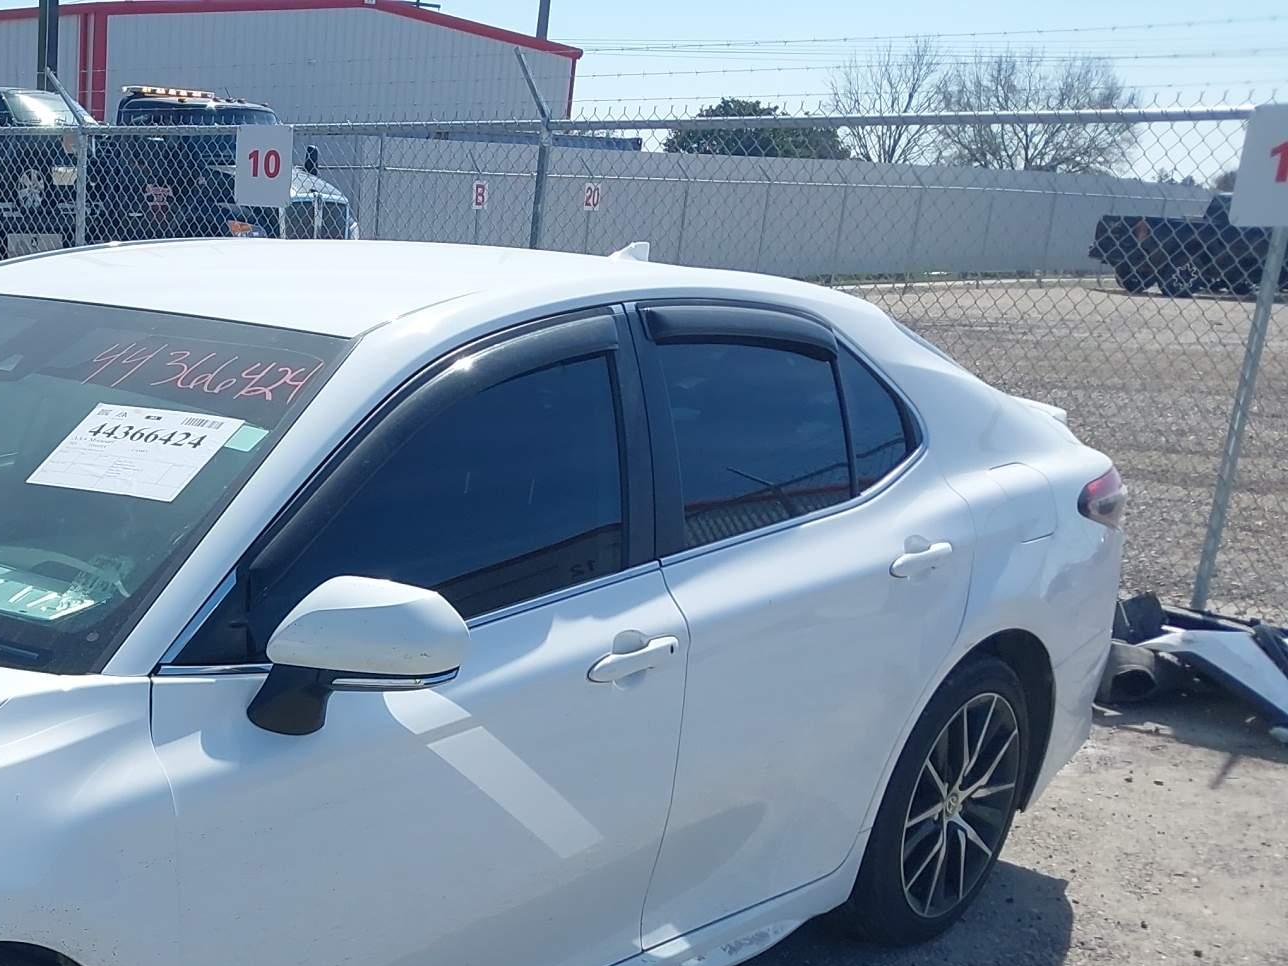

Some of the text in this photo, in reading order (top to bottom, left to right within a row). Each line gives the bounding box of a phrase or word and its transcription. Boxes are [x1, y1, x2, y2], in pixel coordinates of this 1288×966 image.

[248, 149, 281, 178] 10
[475, 184, 485, 206] B
[584, 186, 600, 207] 20
[88, 422, 207, 449] 44366424
